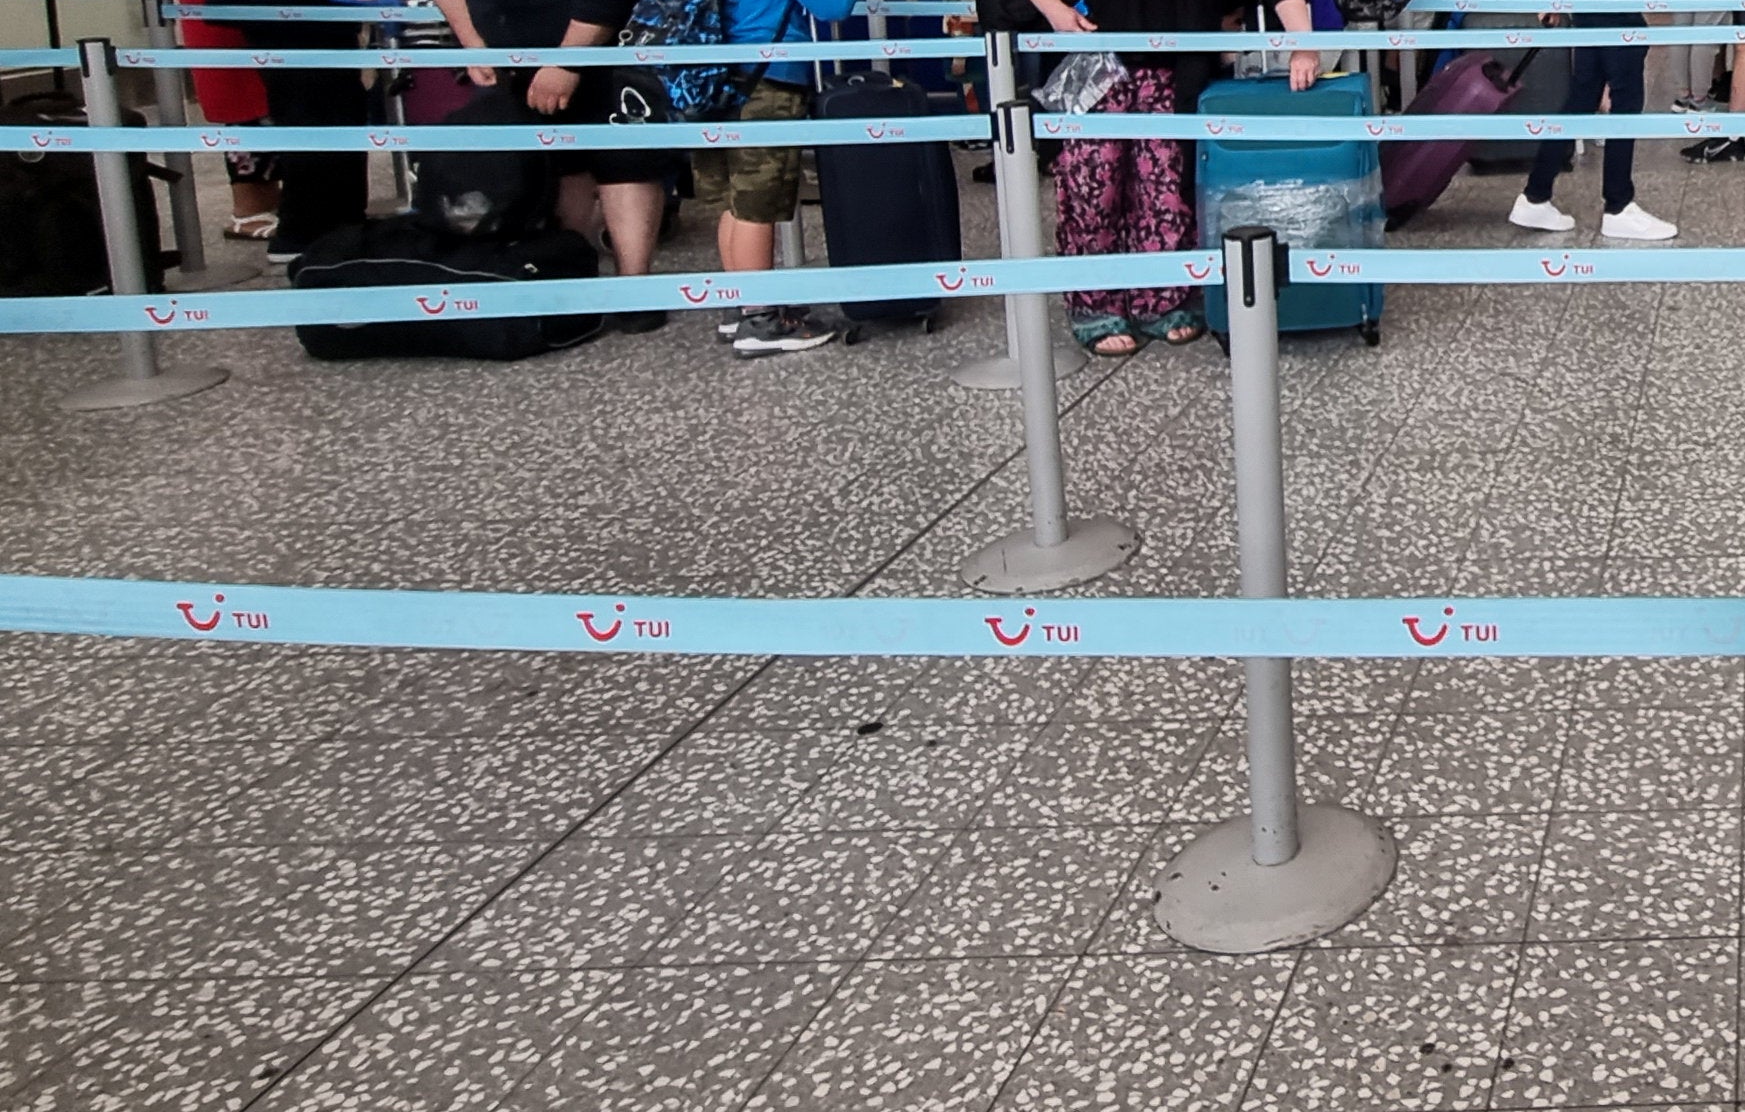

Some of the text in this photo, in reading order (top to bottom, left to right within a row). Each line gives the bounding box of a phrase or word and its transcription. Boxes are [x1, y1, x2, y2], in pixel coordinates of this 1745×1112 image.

[1340, 265, 1359, 273] TUI
[1574, 265, 1593, 274] TUI
[972, 277, 993, 287] TUI
[717, 290, 739, 299] TUI
[455, 301, 478, 310] TUI
[184, 311, 208, 321] TUI
[232, 613, 268, 628] TUI
[634, 621, 669, 637] TUI
[1042, 626, 1078, 641] TUI
[1461, 626, 1496, 641] TUI
